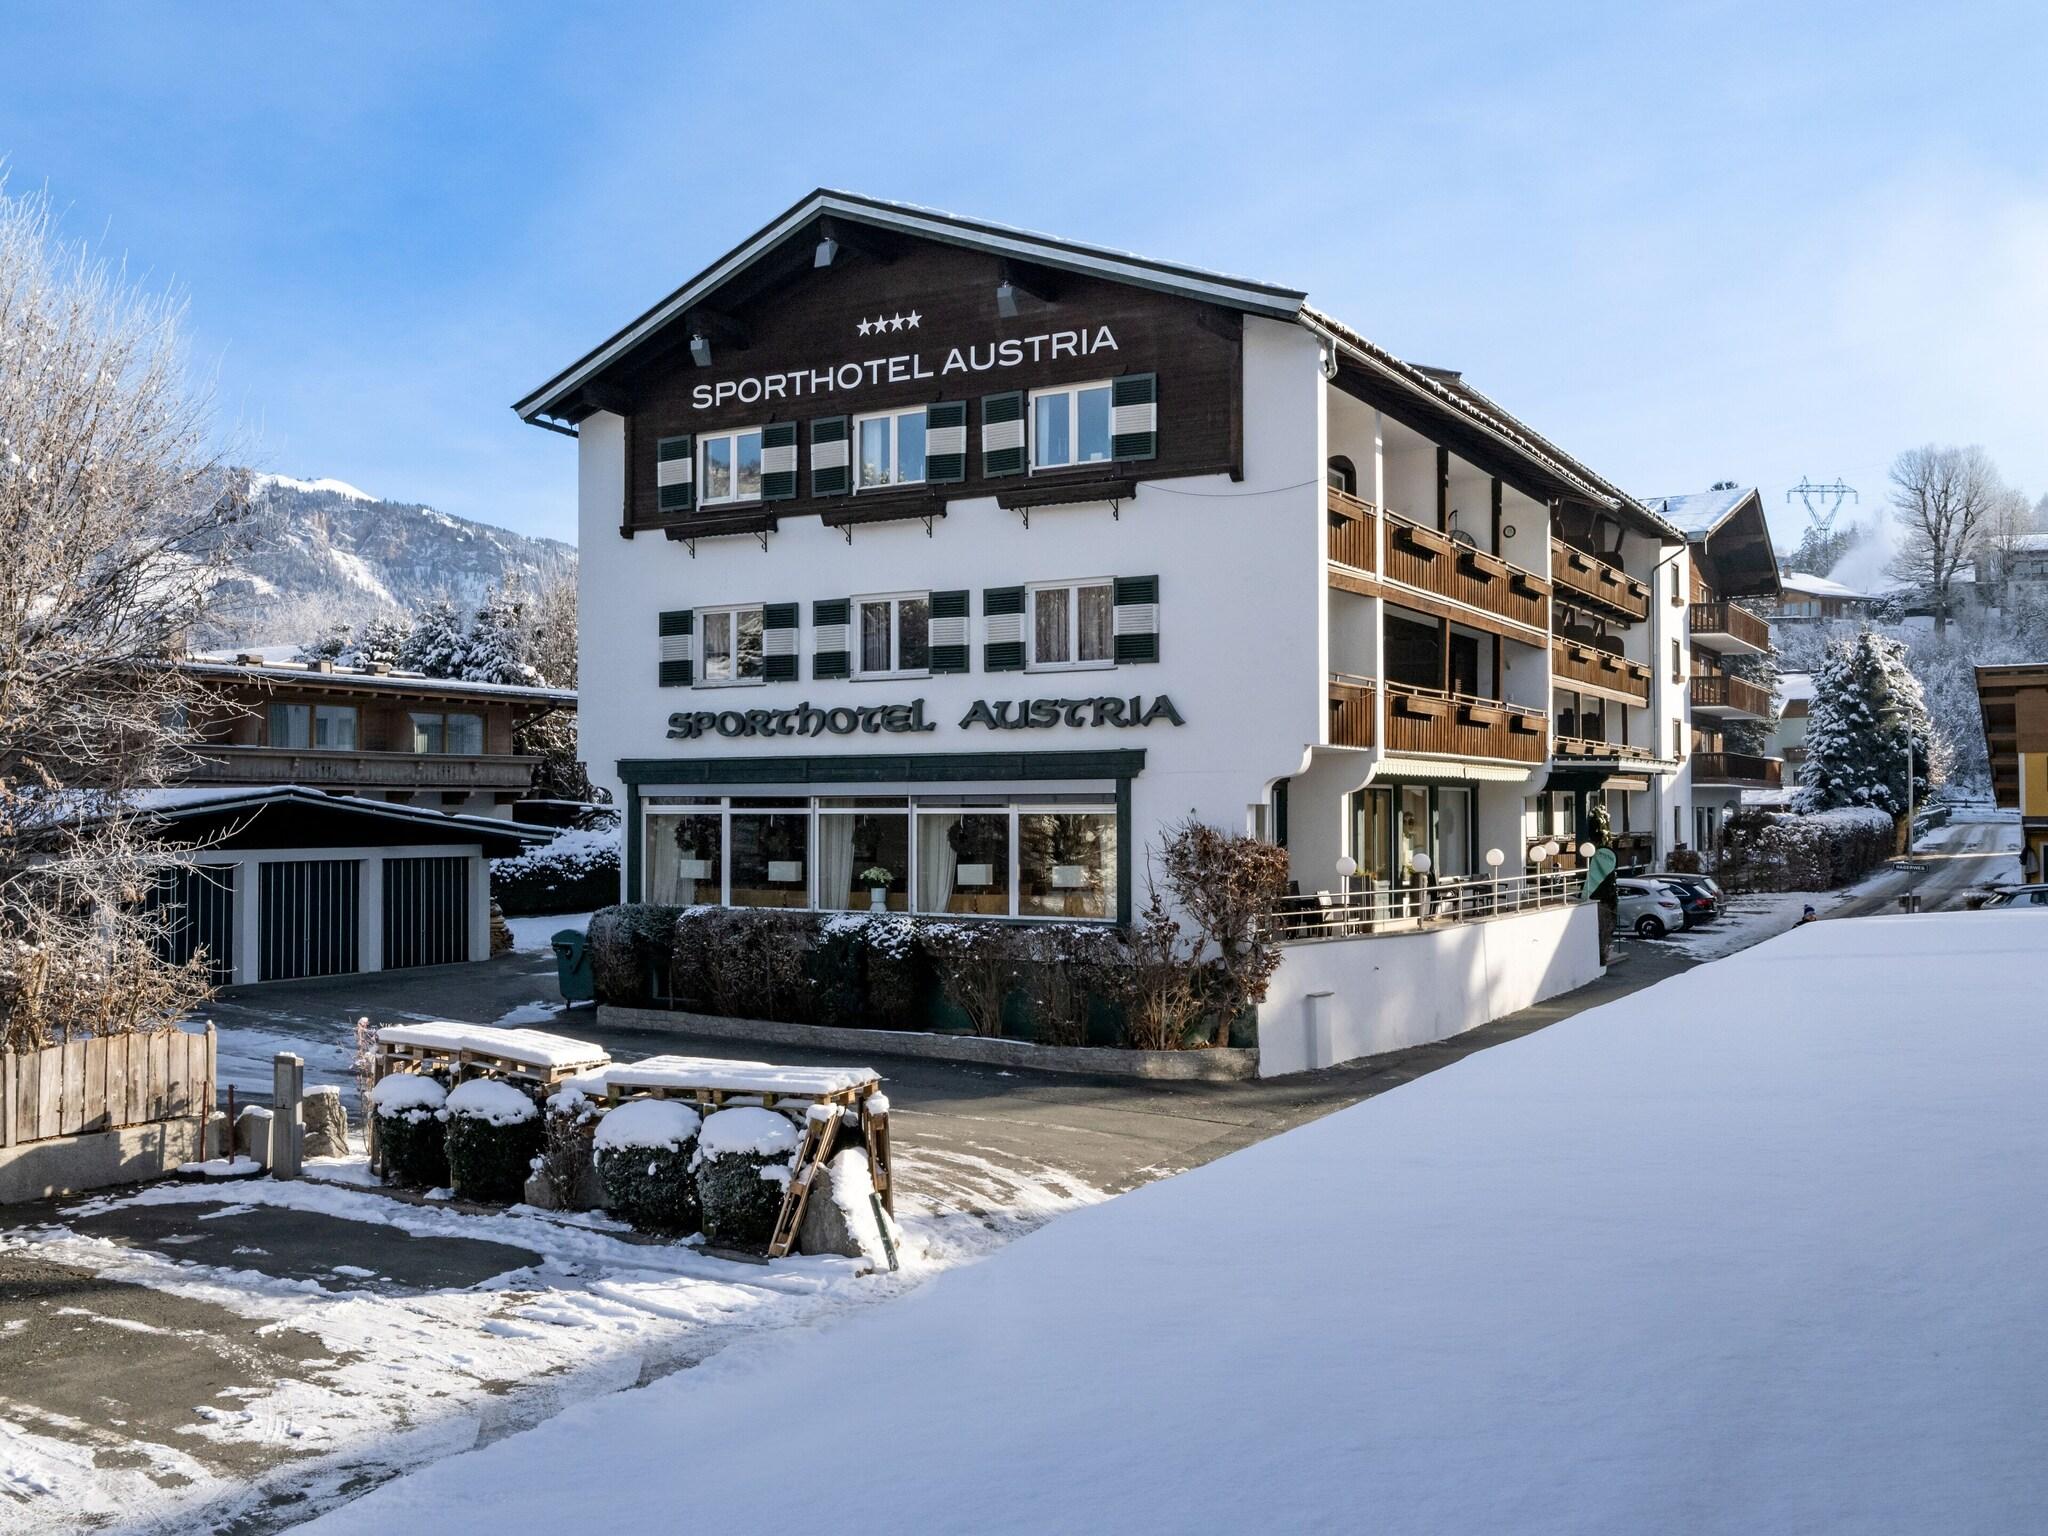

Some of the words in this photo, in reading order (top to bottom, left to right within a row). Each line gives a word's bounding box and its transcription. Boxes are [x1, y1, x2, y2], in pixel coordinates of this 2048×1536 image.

[692, 353, 934, 409] SPORTHOTEL
[941, 325, 1119, 375] AUSTRIA
[666, 698, 937, 739] SPORTHOTEL
[958, 694, 1186, 730] AUSTRIA
